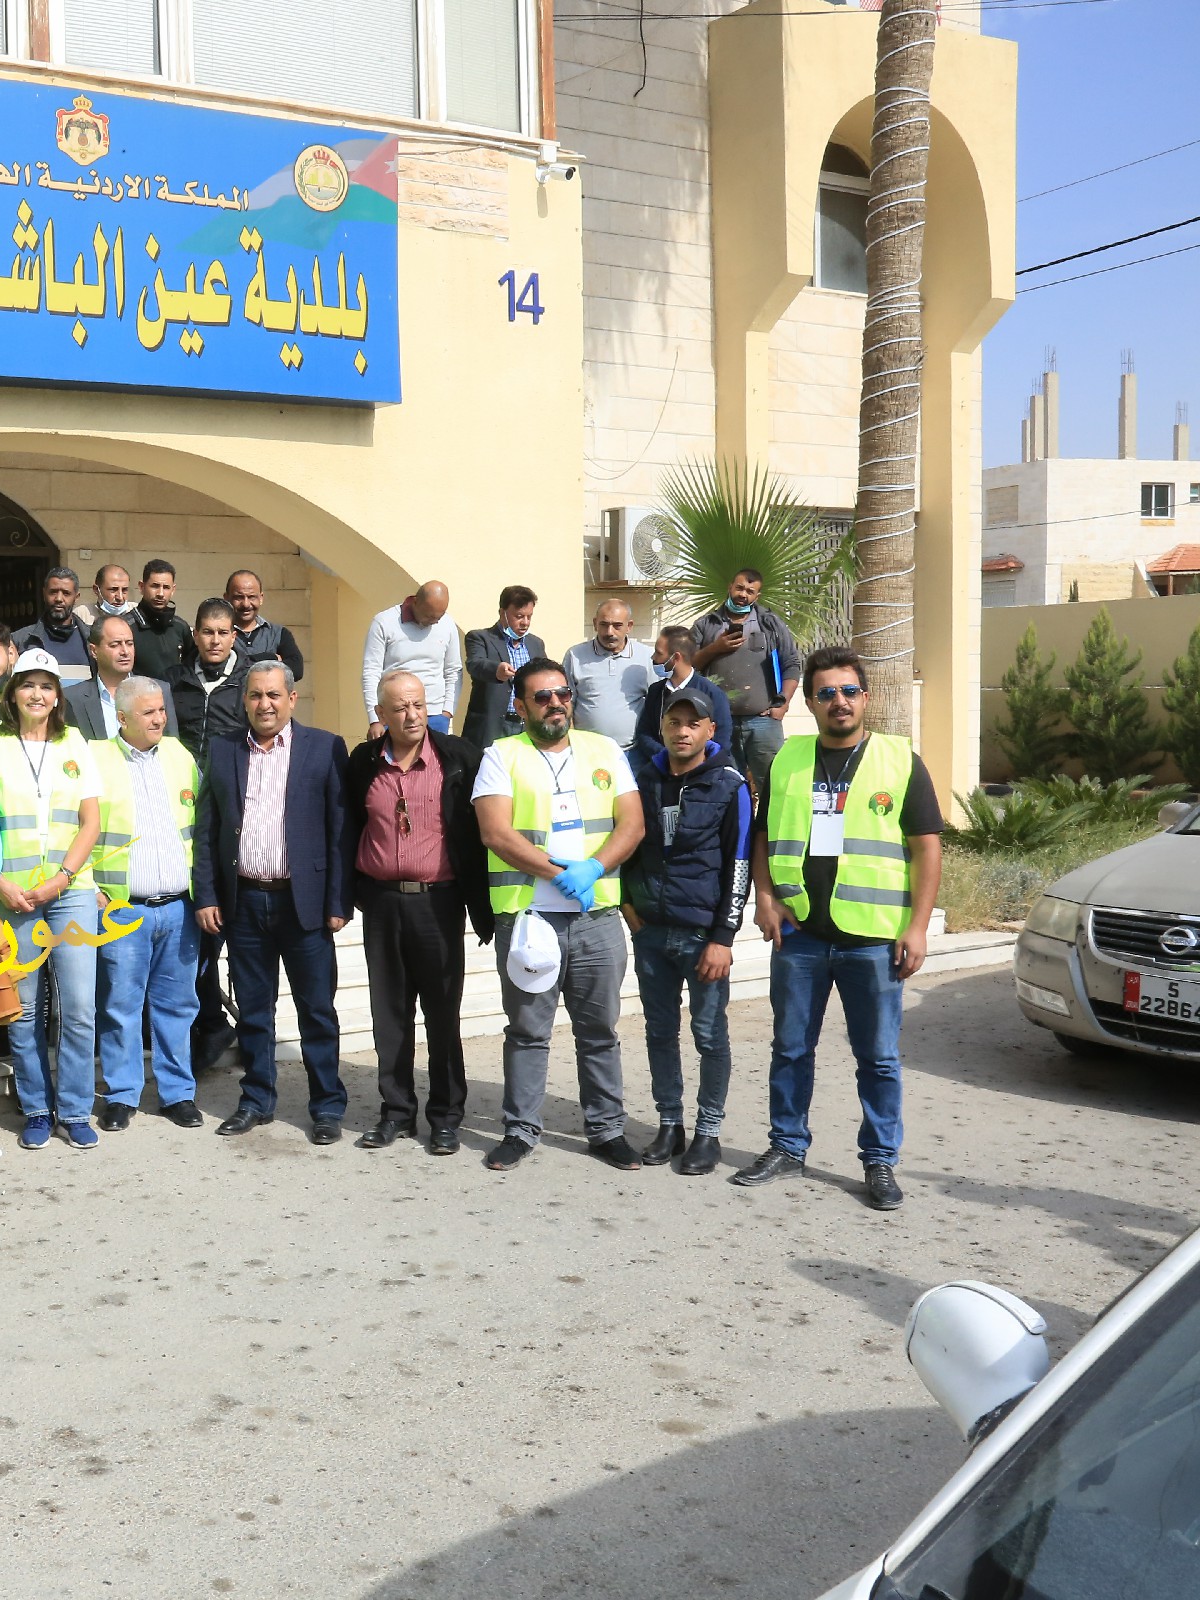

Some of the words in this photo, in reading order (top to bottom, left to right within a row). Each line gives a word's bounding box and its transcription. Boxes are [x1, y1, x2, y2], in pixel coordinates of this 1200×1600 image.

[35, 160, 152, 202] الاردنية
[154, 173, 250, 212] المملكة
[136, 232, 233, 357] عين
[238, 225, 369, 376] بلدية
[498, 269, 545, 325] 14
[727, 896, 745, 926] SAY
[1168, 981, 1179, 998] 5
